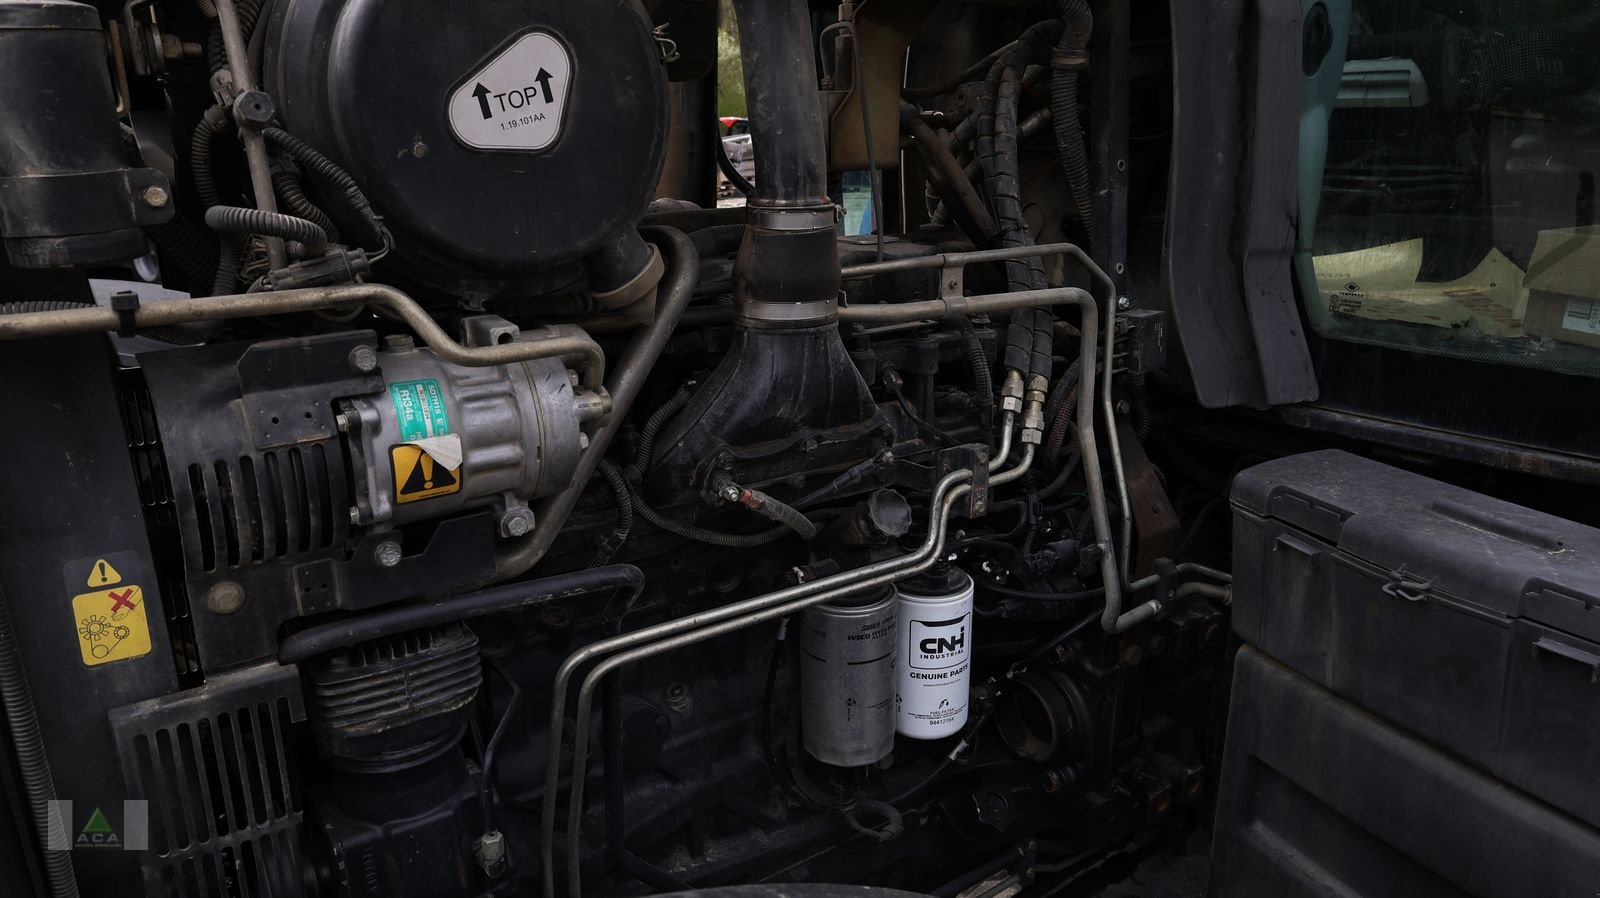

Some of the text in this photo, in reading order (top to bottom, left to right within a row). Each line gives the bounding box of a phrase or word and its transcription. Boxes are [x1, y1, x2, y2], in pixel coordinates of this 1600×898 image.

[493, 86, 537, 112] TOP
[500, 113, 546, 131] 1.19.101AA
[399, 389, 414, 421] R134a
[920, 649, 965, 660] INDUSTRIAL
[909, 663, 969, 680] GENUINE PARTS
